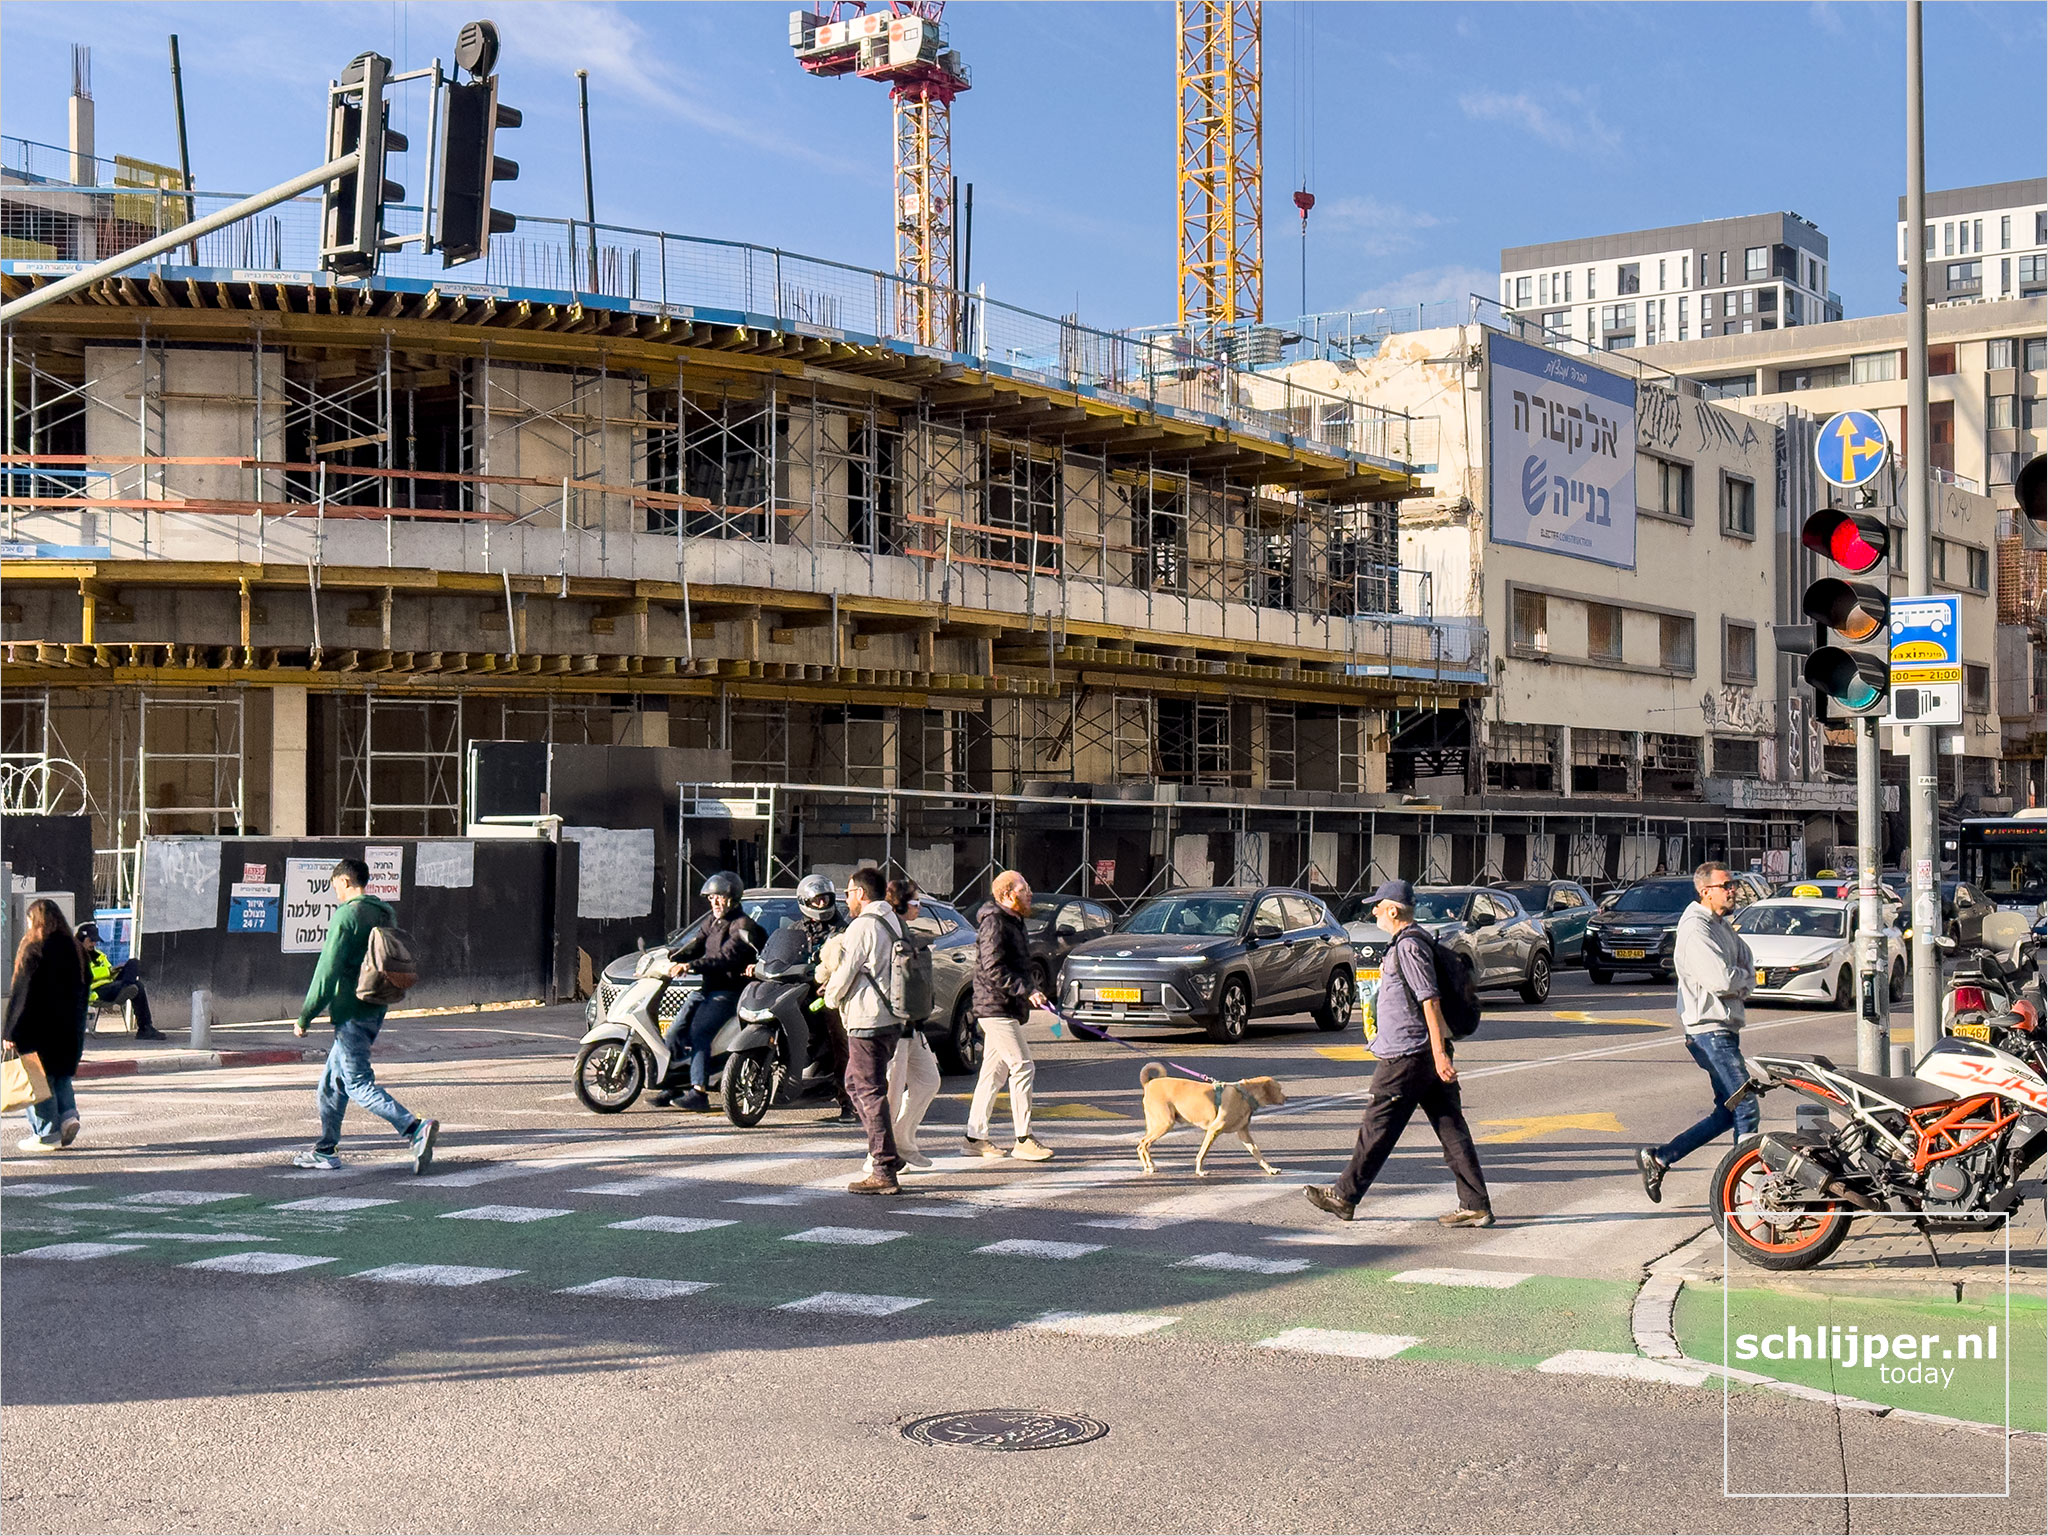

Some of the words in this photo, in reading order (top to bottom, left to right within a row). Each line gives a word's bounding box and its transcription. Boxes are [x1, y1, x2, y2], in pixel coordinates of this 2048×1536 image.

[1512, 389, 1618, 459] אלקטרה
[1553, 474, 1612, 528] בנייה
[1930, 670, 1958, 680] 21:00
[374, 861, 393, 870] החניה
[369, 873, 386, 882] השע
[388, 872, 400, 881] מול
[307, 878, 331, 895] שער
[247, 900, 264, 908] איזור
[243, 909, 266, 918] מצולם
[287, 900, 321, 919] שלמה
